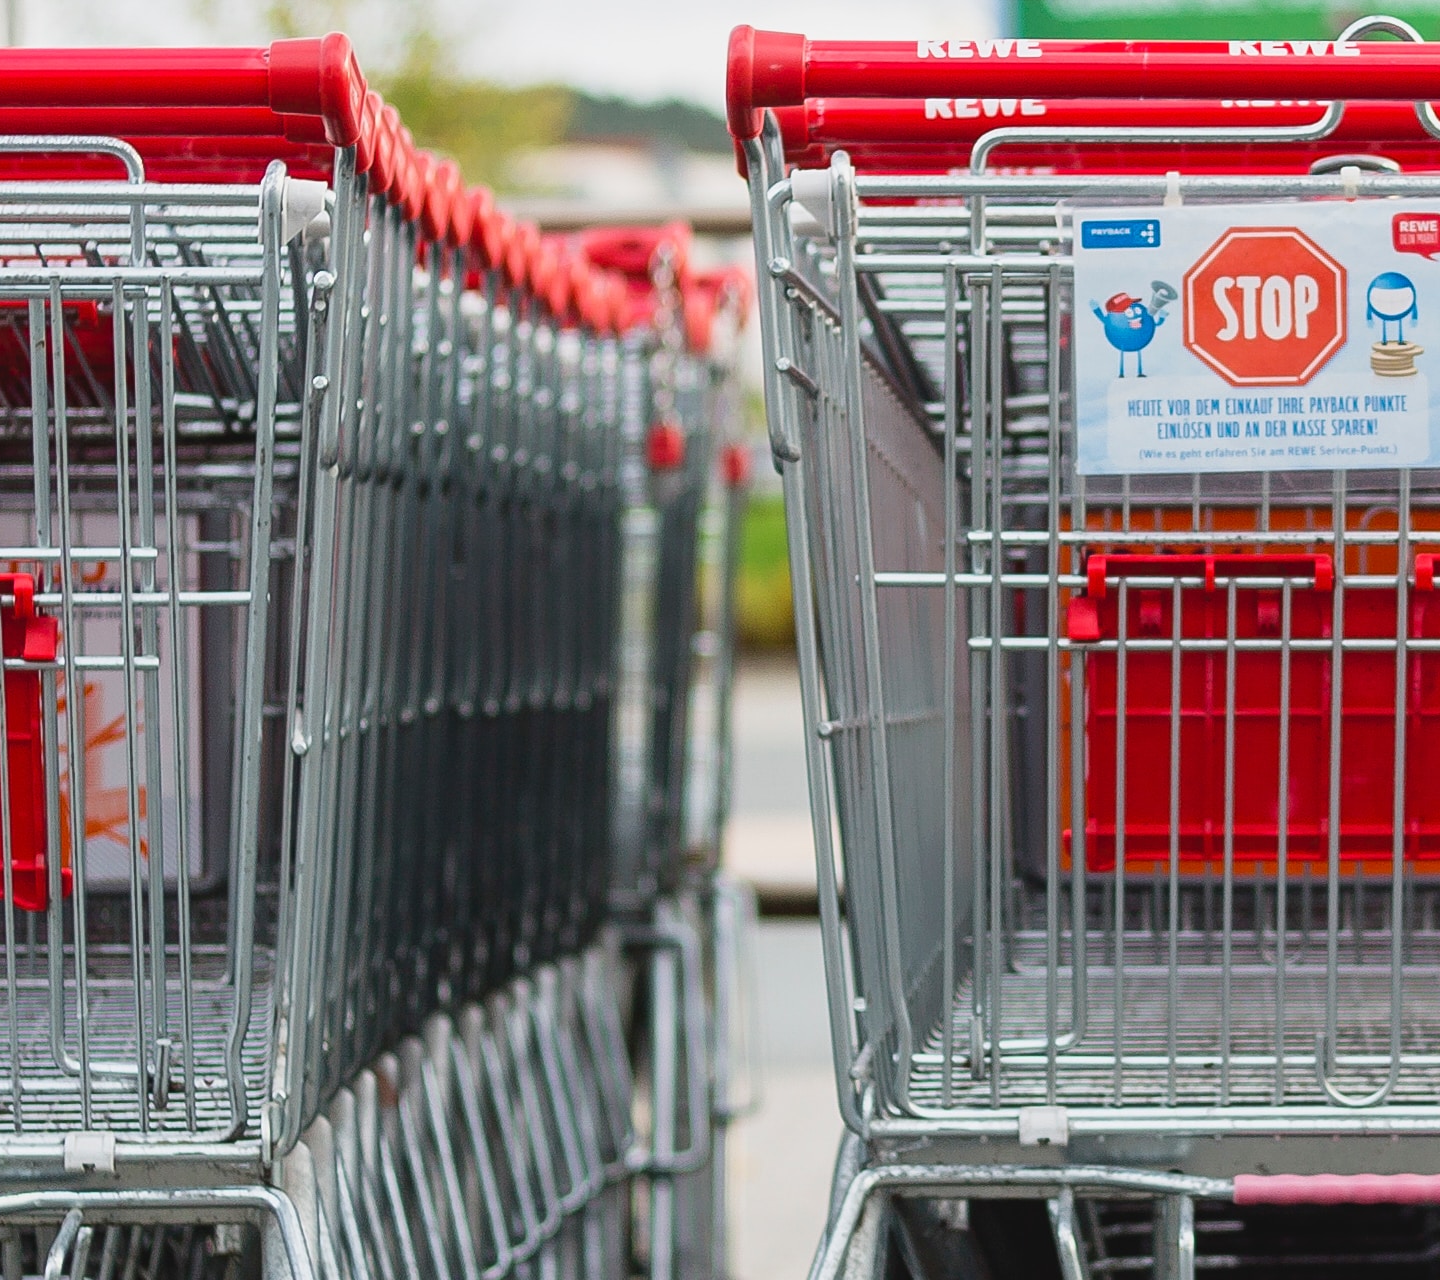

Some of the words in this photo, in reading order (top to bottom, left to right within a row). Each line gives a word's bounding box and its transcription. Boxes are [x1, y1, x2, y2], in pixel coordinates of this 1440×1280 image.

[1399, 220, 1439, 233] REWE
[1212, 275, 1319, 340] STOP
[1128, 400, 1163, 417] HEUTE
[1168, 399, 1191, 416] VOR
[1196, 399, 1220, 416] DEM
[1225, 398, 1273, 415] EINKAUF
[1278, 397, 1305, 414] IHRE
[1310, 396, 1359, 414] PAYBACK
[1364, 395, 1408, 413] PUNKTE
[1157, 419, 1211, 439] EINLÖSEN
[1217, 421, 1240, 438] UND
[1245, 421, 1260, 438] AN
[1265, 420, 1287, 437] DER
[1293, 419, 1327, 437] KASSE
[1331, 418, 1378, 436] SPAREN!
[1139, 449, 1163, 460] (Wie
[1166, 451, 1177, 459] es
[1180, 448, 1206, 461] geht
[1207, 447, 1249, 459] erfahren
[1251, 446, 1268, 457] Sie
[1270, 448, 1285, 457] am
[1288, 446, 1317, 456] REWE
